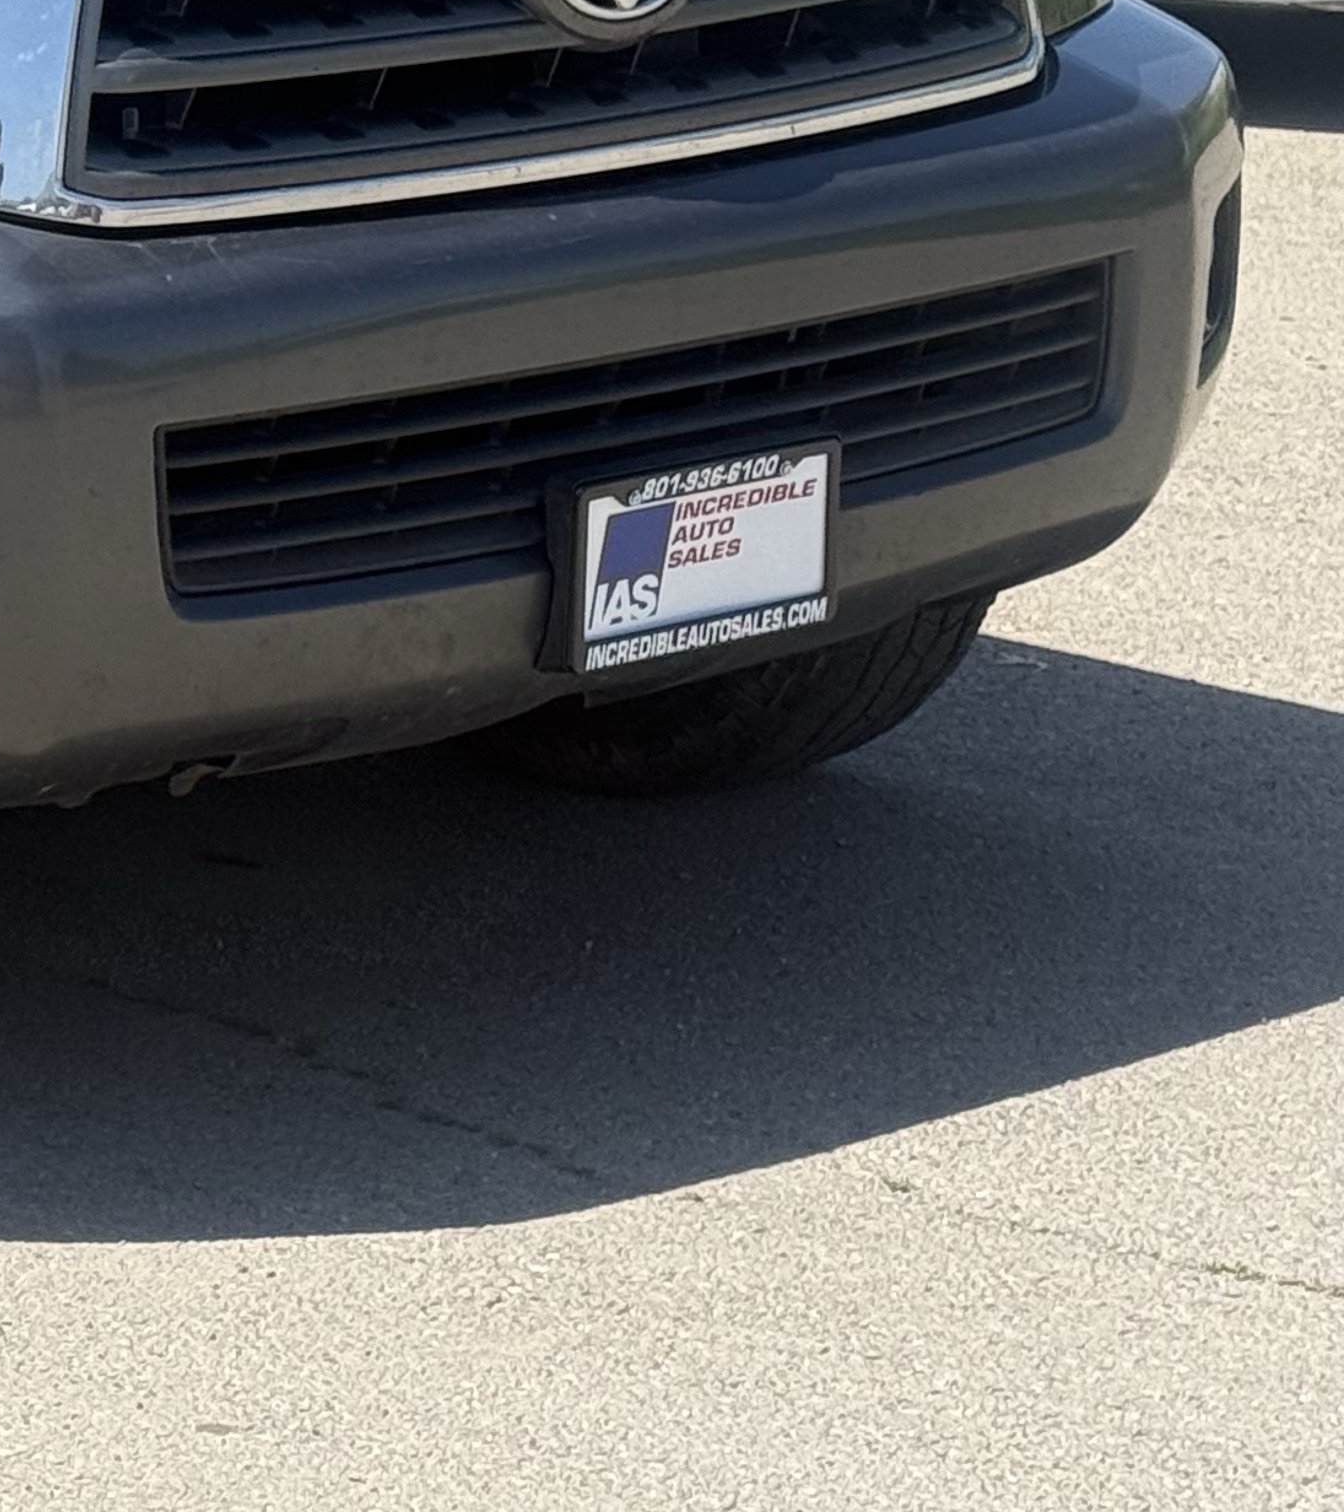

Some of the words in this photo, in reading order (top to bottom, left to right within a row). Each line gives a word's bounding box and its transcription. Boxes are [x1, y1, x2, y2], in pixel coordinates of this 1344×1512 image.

[643, 455, 779, 500] 801-936-6100
[676, 479, 817, 521] INCREDIBLE
[672, 517, 735, 545] AUTO
[668, 539, 742, 568] SALES
[590, 574, 658, 630] IAS
[586, 598, 827, 670] INCREDIBLEAUTOSALES.COM
